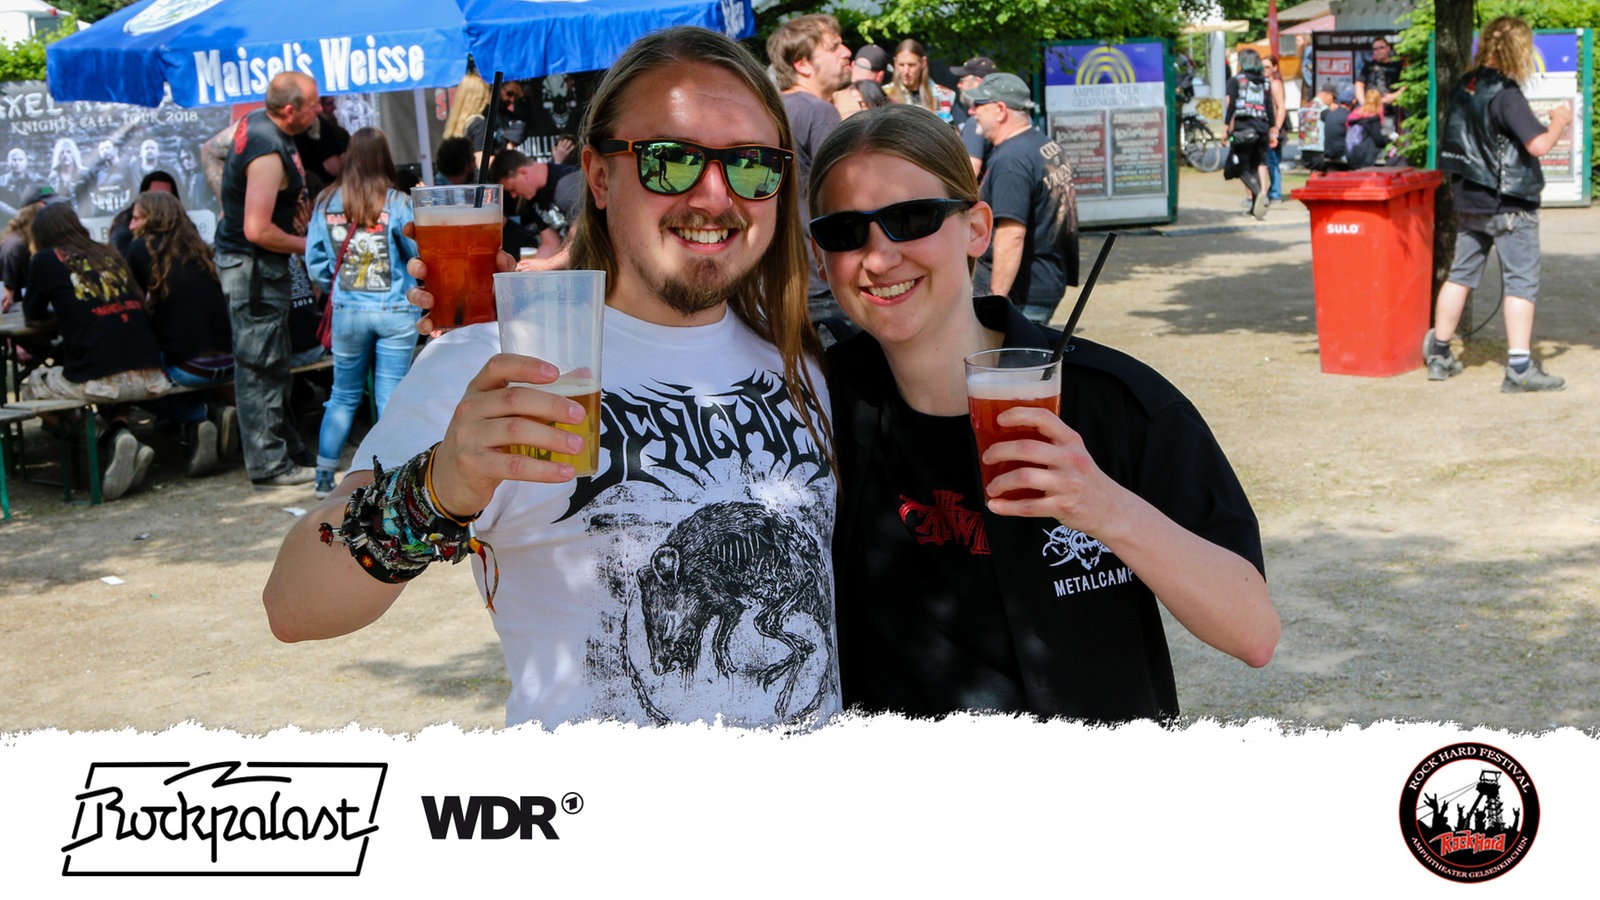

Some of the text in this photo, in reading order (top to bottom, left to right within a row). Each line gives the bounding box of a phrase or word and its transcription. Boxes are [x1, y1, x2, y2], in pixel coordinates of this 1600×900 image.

[193, 35, 425, 104] Maisel's Weisse
[11, 117, 75, 135] KNIGHTS
[79, 116, 119, 129] CALL
[122, 106, 165, 125] TOUR
[165, 111, 199, 122] 2018
[1326, 223, 1360, 235] SULO
